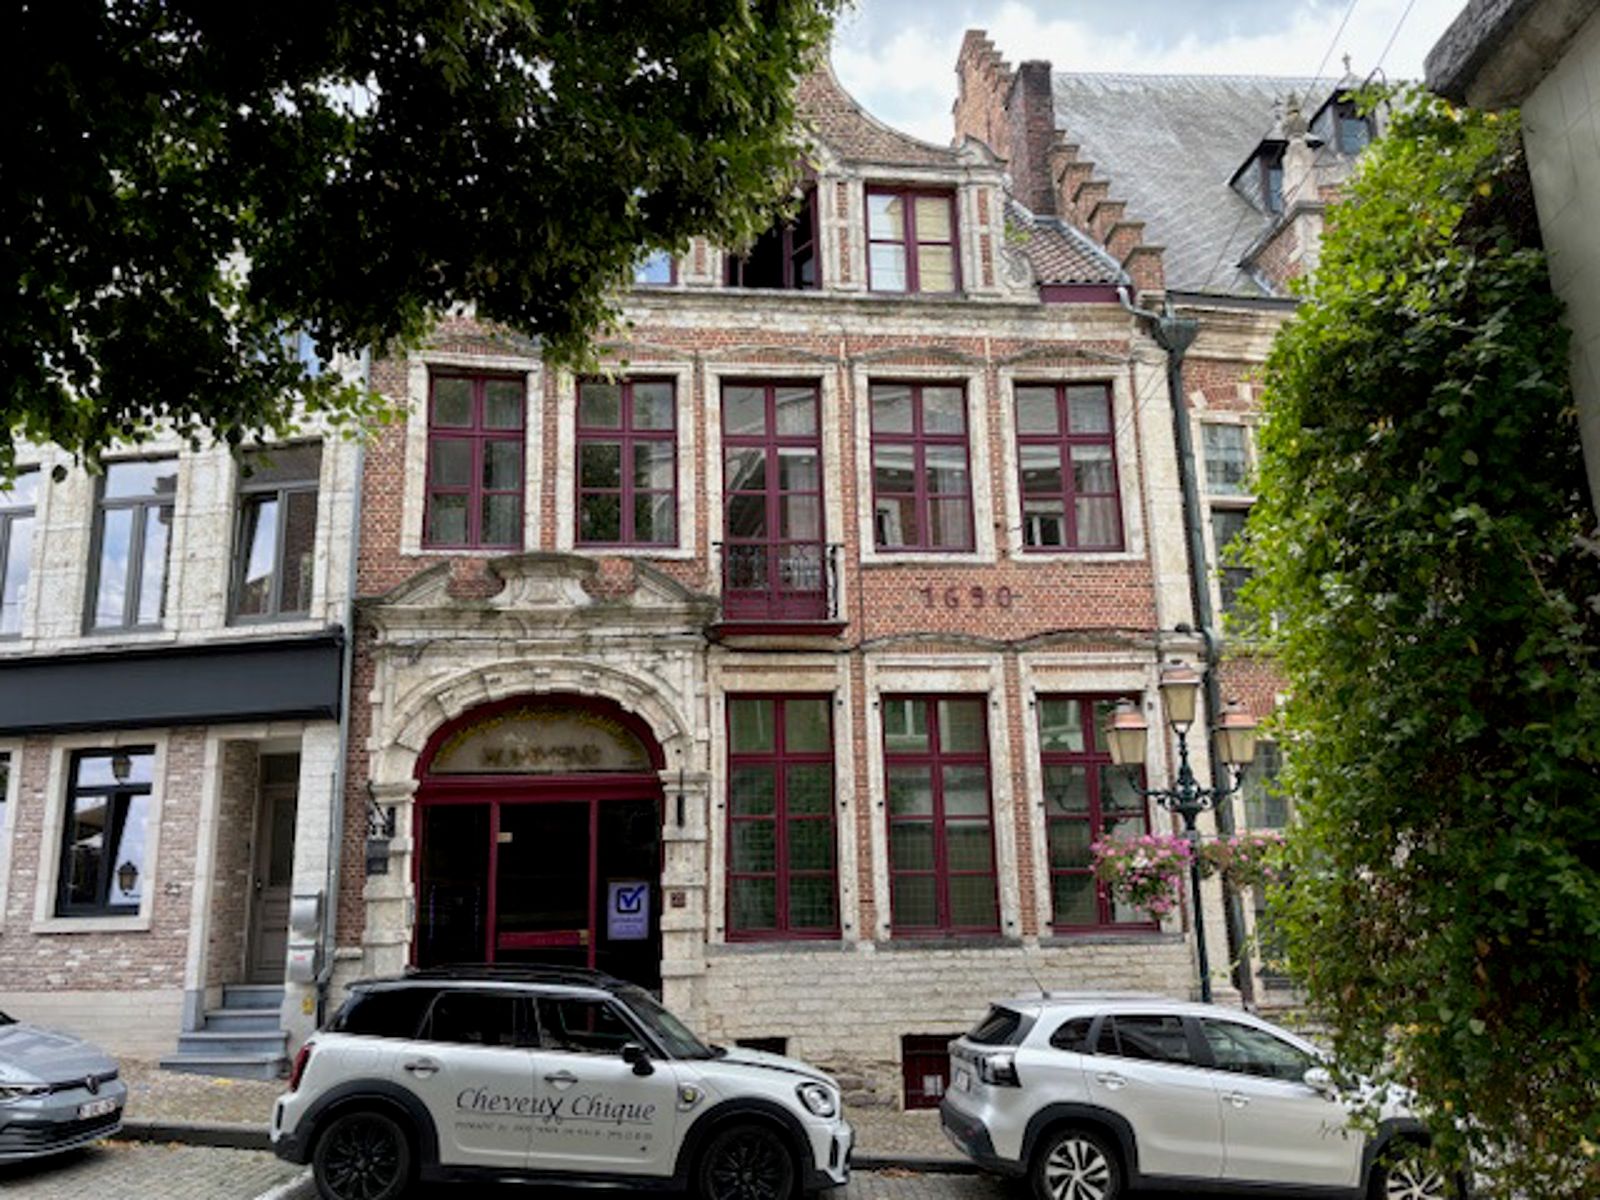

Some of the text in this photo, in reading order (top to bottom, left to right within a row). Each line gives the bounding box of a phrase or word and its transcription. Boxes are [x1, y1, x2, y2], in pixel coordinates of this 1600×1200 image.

[919, 585, 1012, 609] 1690
[456, 1086, 657, 1125] Cheveux Chique
